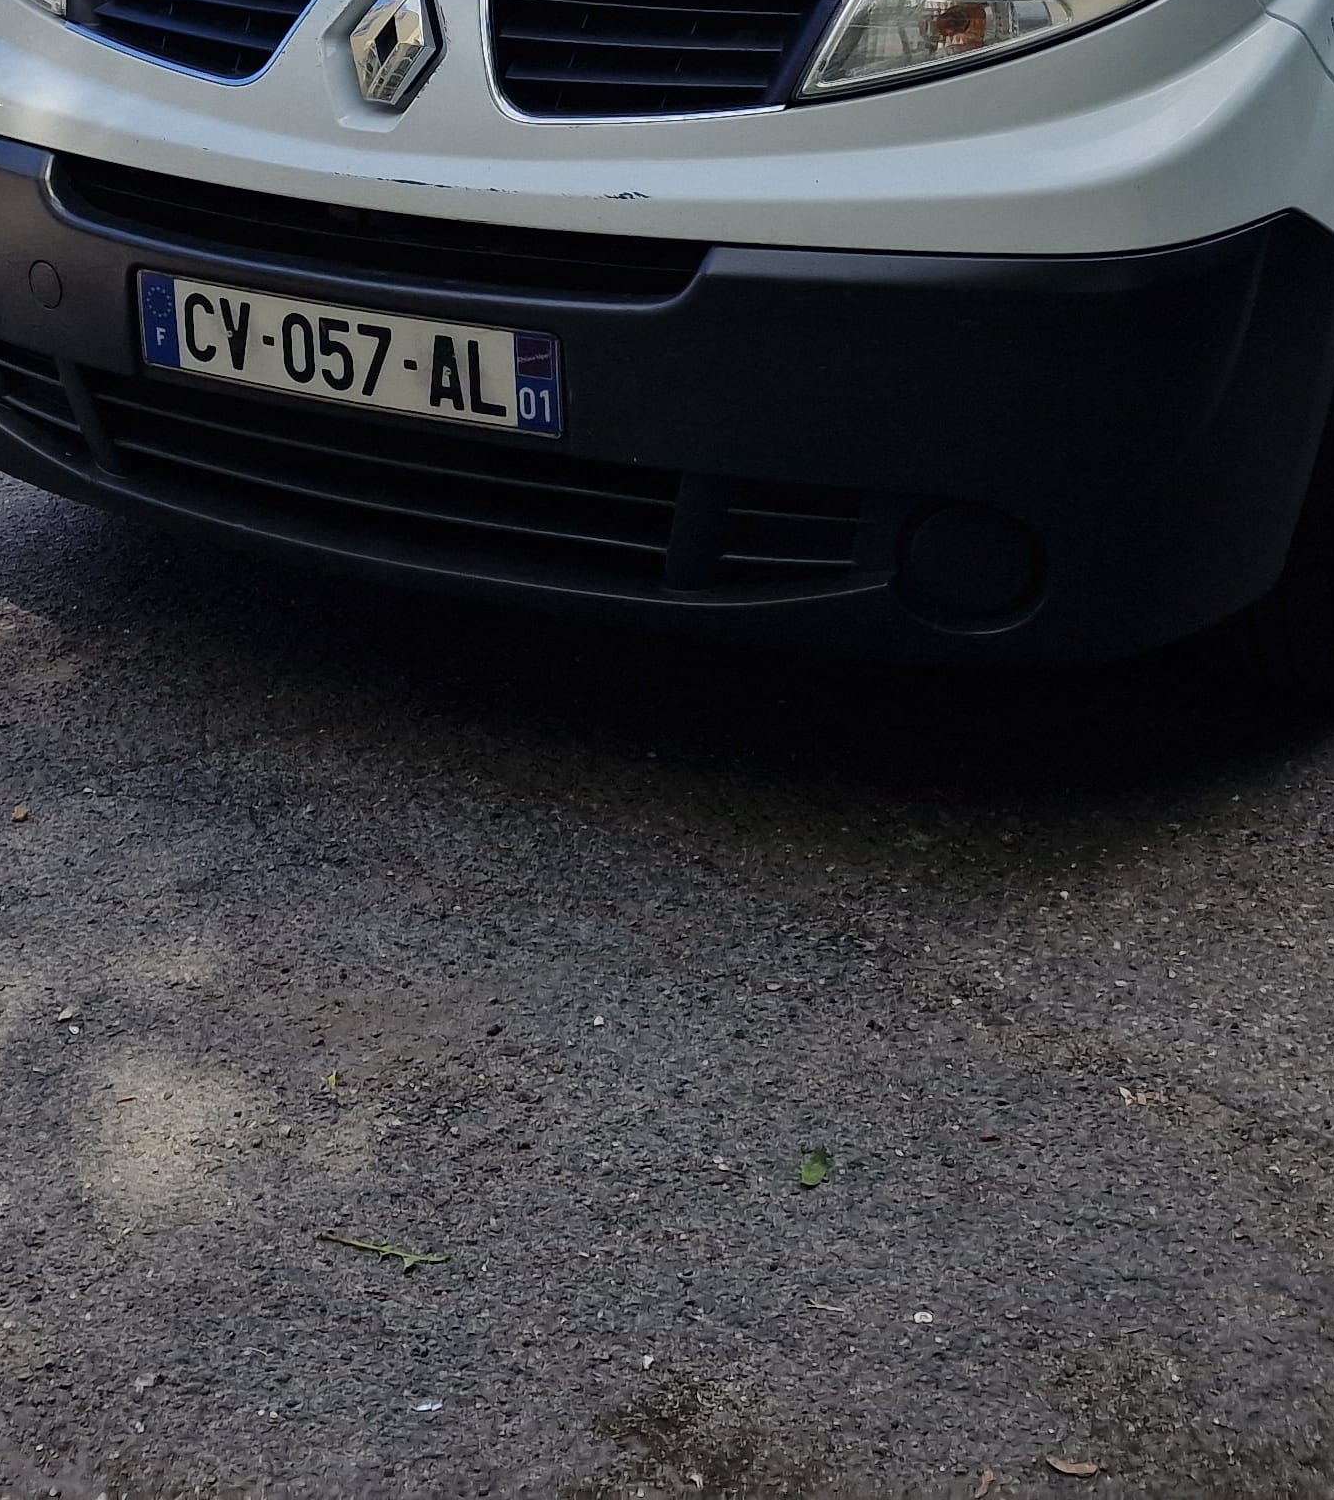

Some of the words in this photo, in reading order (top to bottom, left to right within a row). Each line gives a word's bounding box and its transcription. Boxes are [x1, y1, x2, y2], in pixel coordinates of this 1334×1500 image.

[155, 326, 166, 346] F
[183, 291, 508, 418] CV-057-AL
[518, 386, 552, 423] 01
